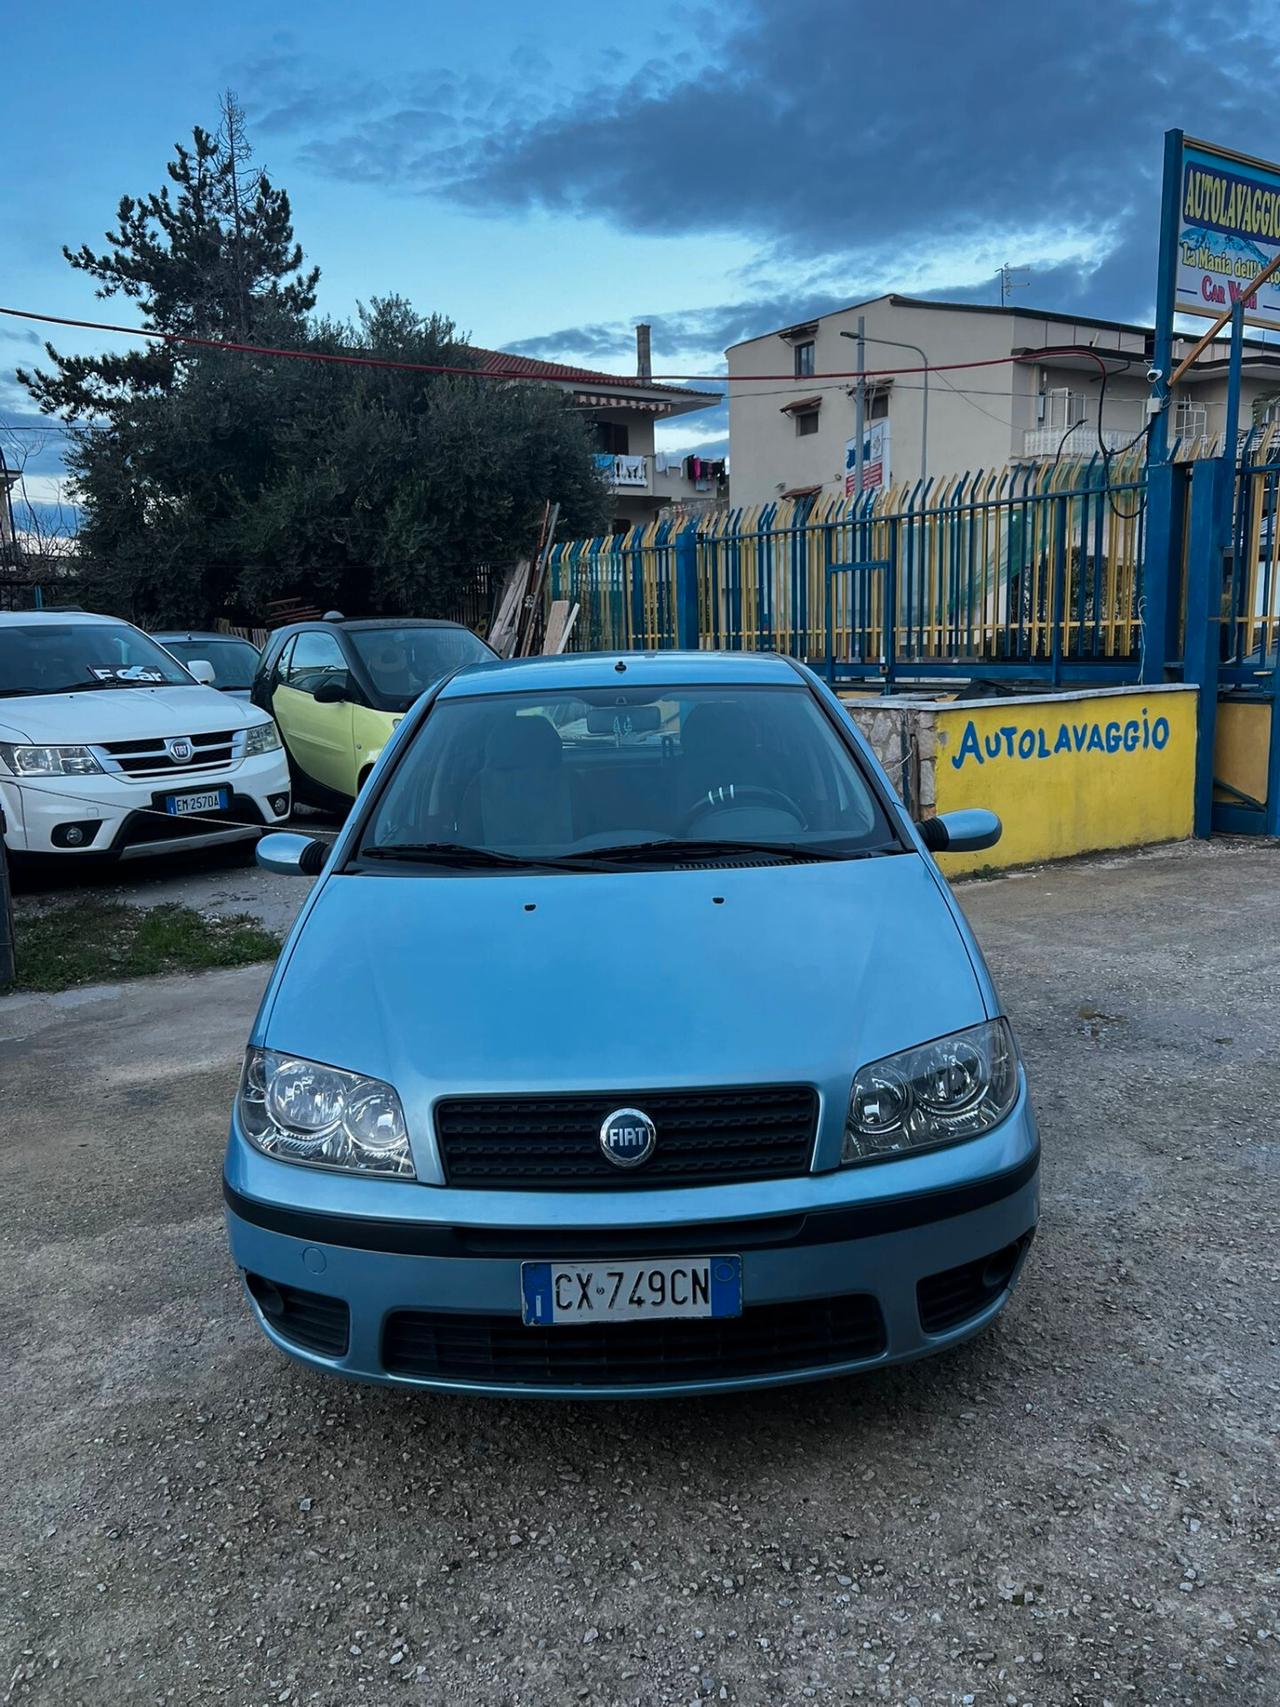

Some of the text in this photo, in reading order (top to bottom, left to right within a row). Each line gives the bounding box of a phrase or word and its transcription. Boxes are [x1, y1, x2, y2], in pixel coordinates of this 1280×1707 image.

[1182, 242, 1196, 267] La
[1199, 246, 1232, 275] Mania
[176, 799, 189, 812] EM
[609, 1127, 646, 1147] FIAT
[555, 1273, 593, 1311] CX
[606, 1268, 709, 1309] 749CN
